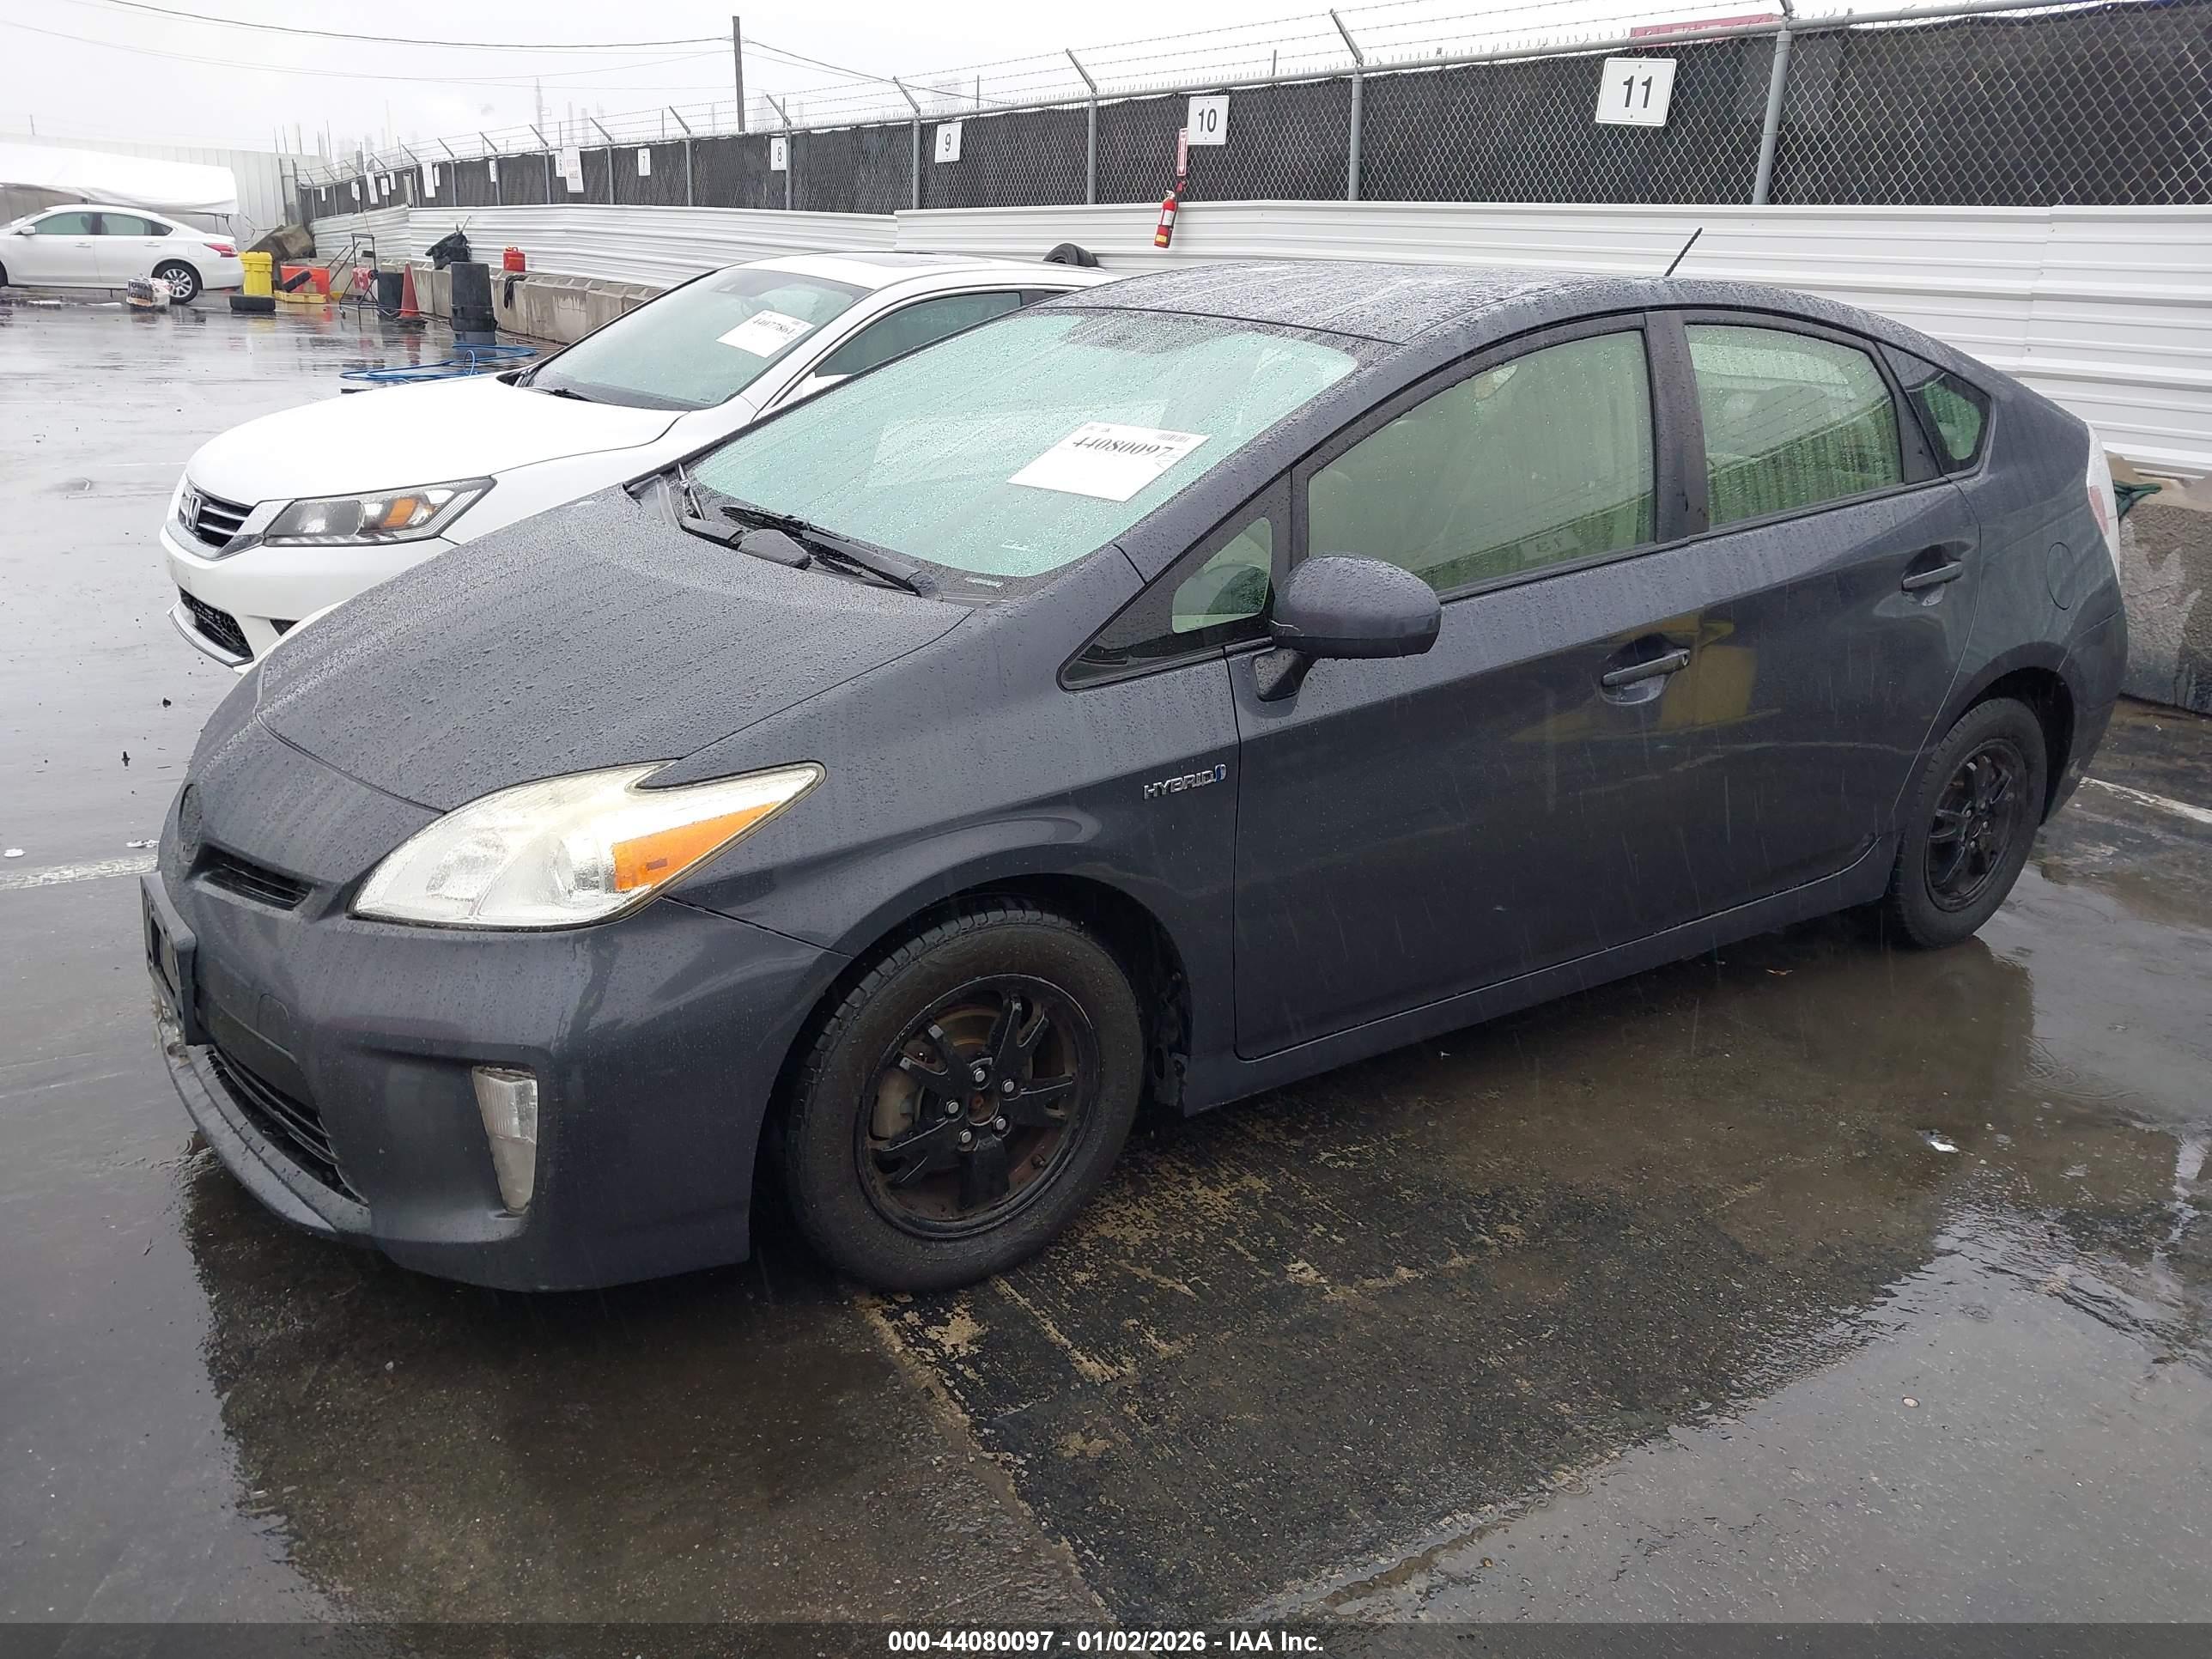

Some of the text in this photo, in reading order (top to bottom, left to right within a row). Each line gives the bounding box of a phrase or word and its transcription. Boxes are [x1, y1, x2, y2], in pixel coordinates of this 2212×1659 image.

[1622, 75, 1653, 109] 11
[1198, 108, 1217, 133] 10
[777, 146, 782, 162] 8
[945, 133, 951, 152] 9
[1073, 436, 1175, 458] 44080097
[1144, 770, 1216, 799] HYBRID
